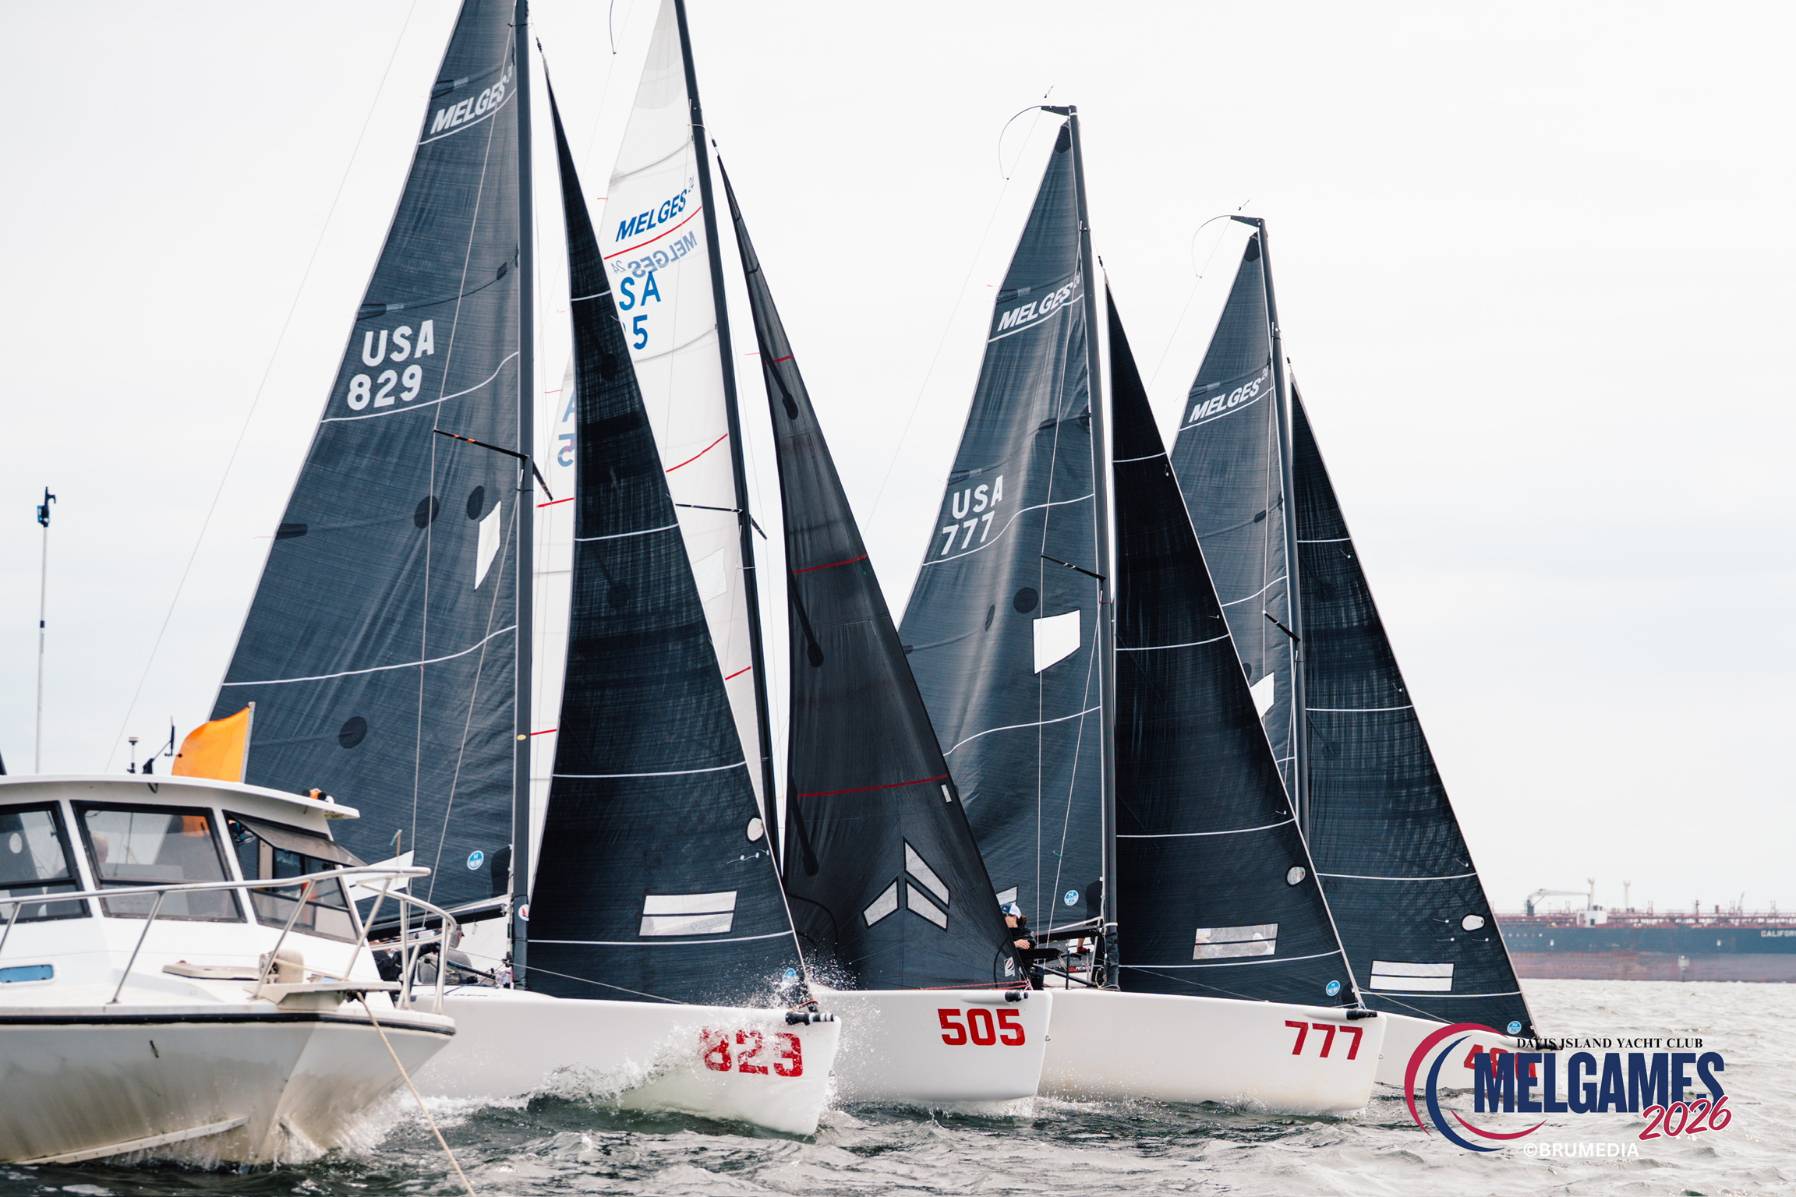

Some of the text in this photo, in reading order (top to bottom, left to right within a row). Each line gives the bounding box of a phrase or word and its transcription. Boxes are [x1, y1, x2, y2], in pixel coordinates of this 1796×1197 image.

[430, 80, 506, 135] MELGES
[615, 188, 687, 242] MELGES
[618, 271, 662, 311] SA
[997, 281, 1073, 332] MELGES
[361, 319, 435, 367] USA
[347, 364, 423, 411] 829
[1188, 377, 1261, 423] MELGES
[952, 475, 1004, 519] USA
[941, 511, 996, 556] 777
[937, 1008, 1026, 1046] 505
[1284, 1020, 1364, 1061] 777
